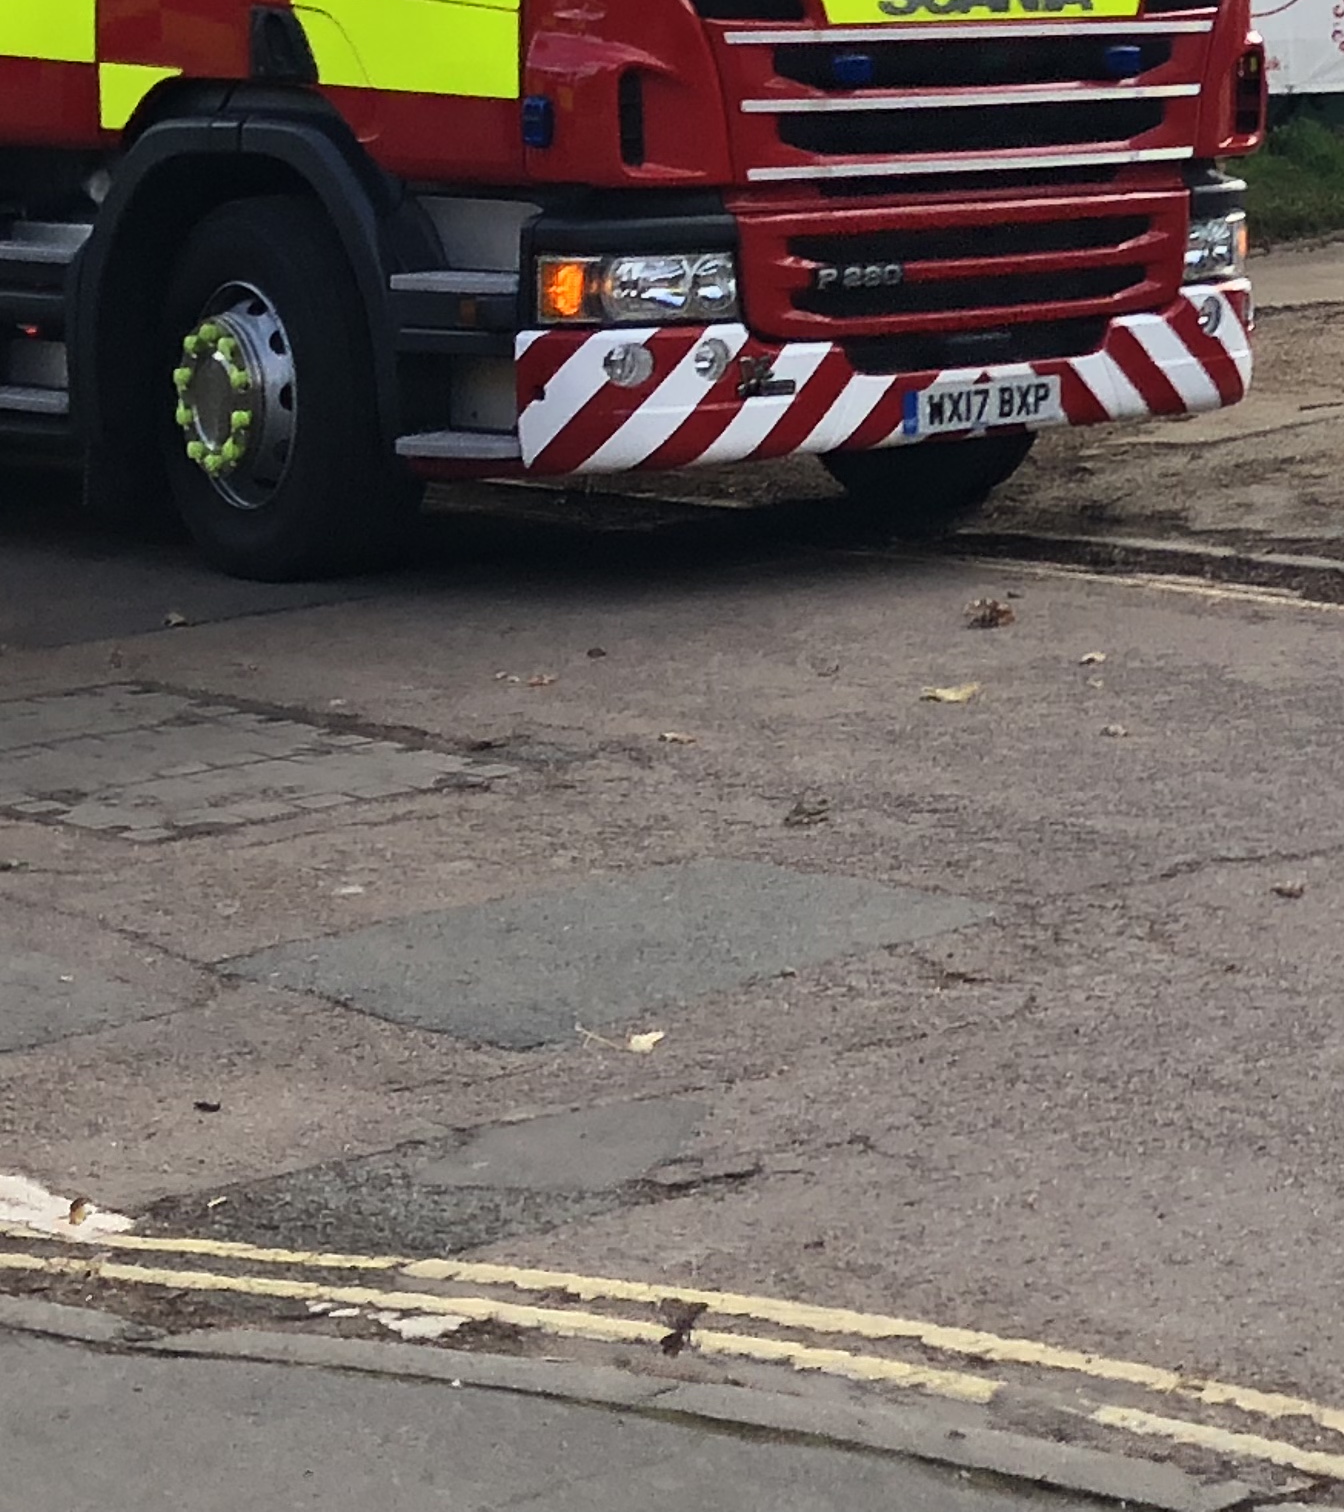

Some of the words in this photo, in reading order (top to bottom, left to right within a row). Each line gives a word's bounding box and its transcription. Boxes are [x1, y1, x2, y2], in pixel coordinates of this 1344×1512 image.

[817, 268, 838, 289] P
[926, 389, 990, 426] WX17
[998, 383, 1050, 418] BXP
